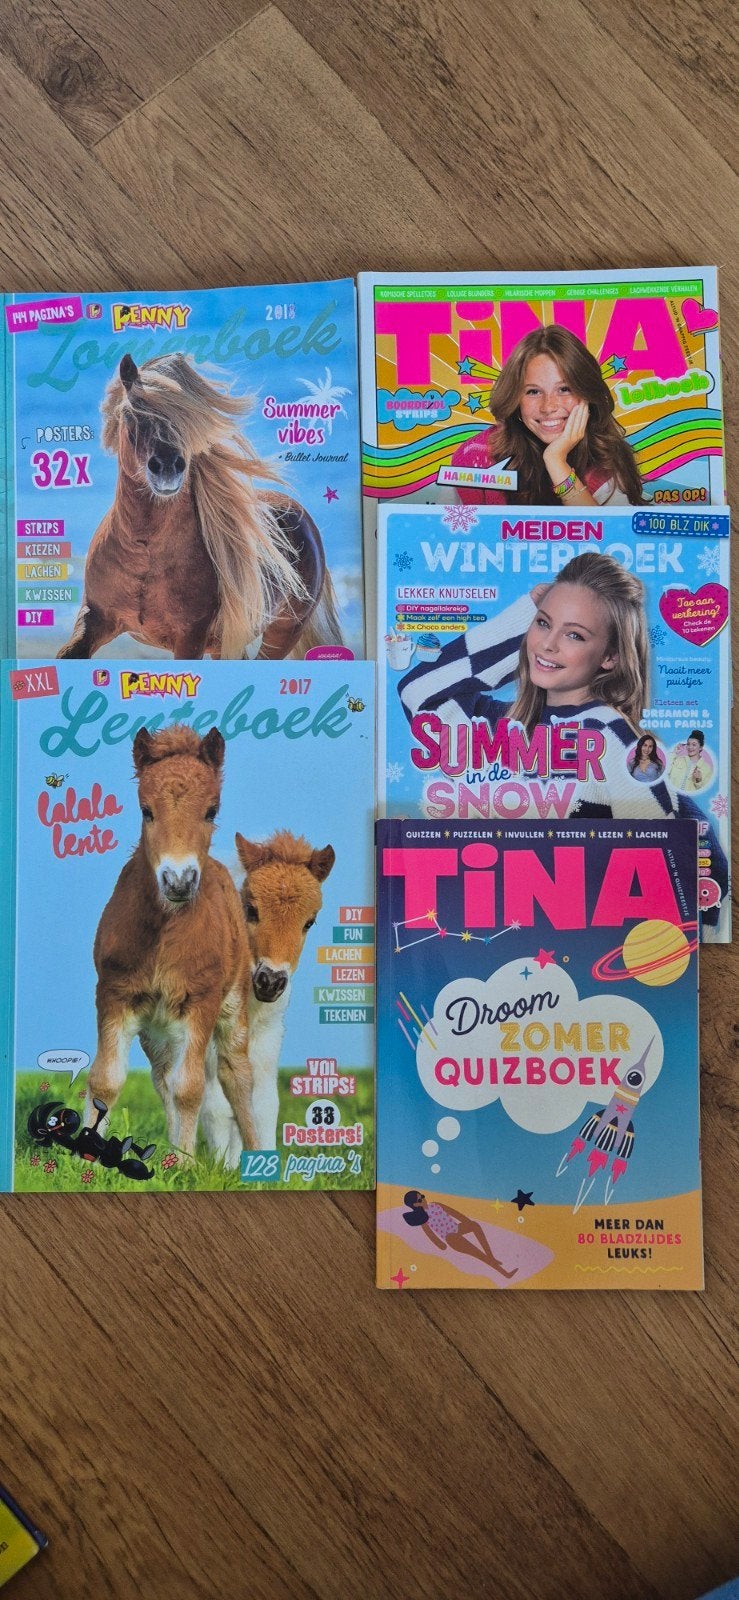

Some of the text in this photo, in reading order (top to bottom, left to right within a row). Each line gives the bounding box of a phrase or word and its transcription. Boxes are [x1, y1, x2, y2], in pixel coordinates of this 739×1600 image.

[29, 305, 75, 322] PAGINA'S
[112, 303, 191, 333] PENNY
[263, 397, 341, 419] Summer
[395, 410, 438, 418] STRIPS
[36, 425, 94, 443] POSTERS:
[277, 420, 325, 445] vibes
[654, 487, 707, 504] PAS OP!
[25, 522, 59, 534] STRIPS
[501, 520, 604, 541] MEIDEN
[649, 518, 710, 532] 100 BLZ DIK
[25, 544, 61, 556] KIEZEN
[25, 565, 61, 578] LACHEN
[25, 589, 72, 601] KWISSEN
[397, 587, 497, 599] LEKKER KNUTSELEN
[695, 597, 716, 606] aan
[25, 612, 42, 623] DIY
[456, 614, 472, 623] high
[658, 664, 712, 675] Nooit meer
[24, 672, 54, 693] XXL
[119, 670, 202, 700] PENNY
[279, 678, 312, 695] 2017
[666, 677, 704, 689] puistjes
[411, 712, 607, 783] SUMMER
[466, 762, 512, 785] in de
[37, 782, 124, 827] lalala
[426, 781, 577, 819] SNOW
[52, 823, 119, 860] lente
[405, 831, 668, 839] QUIZZEN PUZZELEN INVULLEN TESTEN LEZEN LACHEN
[345, 908, 363, 921] DIY
[343, 928, 363, 941] FUN
[325, 948, 362, 961] LACHEN
[336, 969, 365, 981] LEZEN
[318, 988, 366, 1001] KWISSEN
[324, 1009, 367, 1022] TEKENEN
[445, 990, 561, 1037] Droom
[500, 1020, 631, 1052] ZOMER
[308, 1059, 339, 1077] VOL
[434, 1056, 622, 1088] QUIZBOEK
[311, 1105, 335, 1126] 33
[284, 1124, 362, 1145] Posters!
[241, 1154, 279, 1178] 128
[594, 1218, 664, 1230] MEER DAN
[577, 1233, 682, 1245] 80 BLADZIJDES
[607, 1247, 652, 1259] LEUKS!
